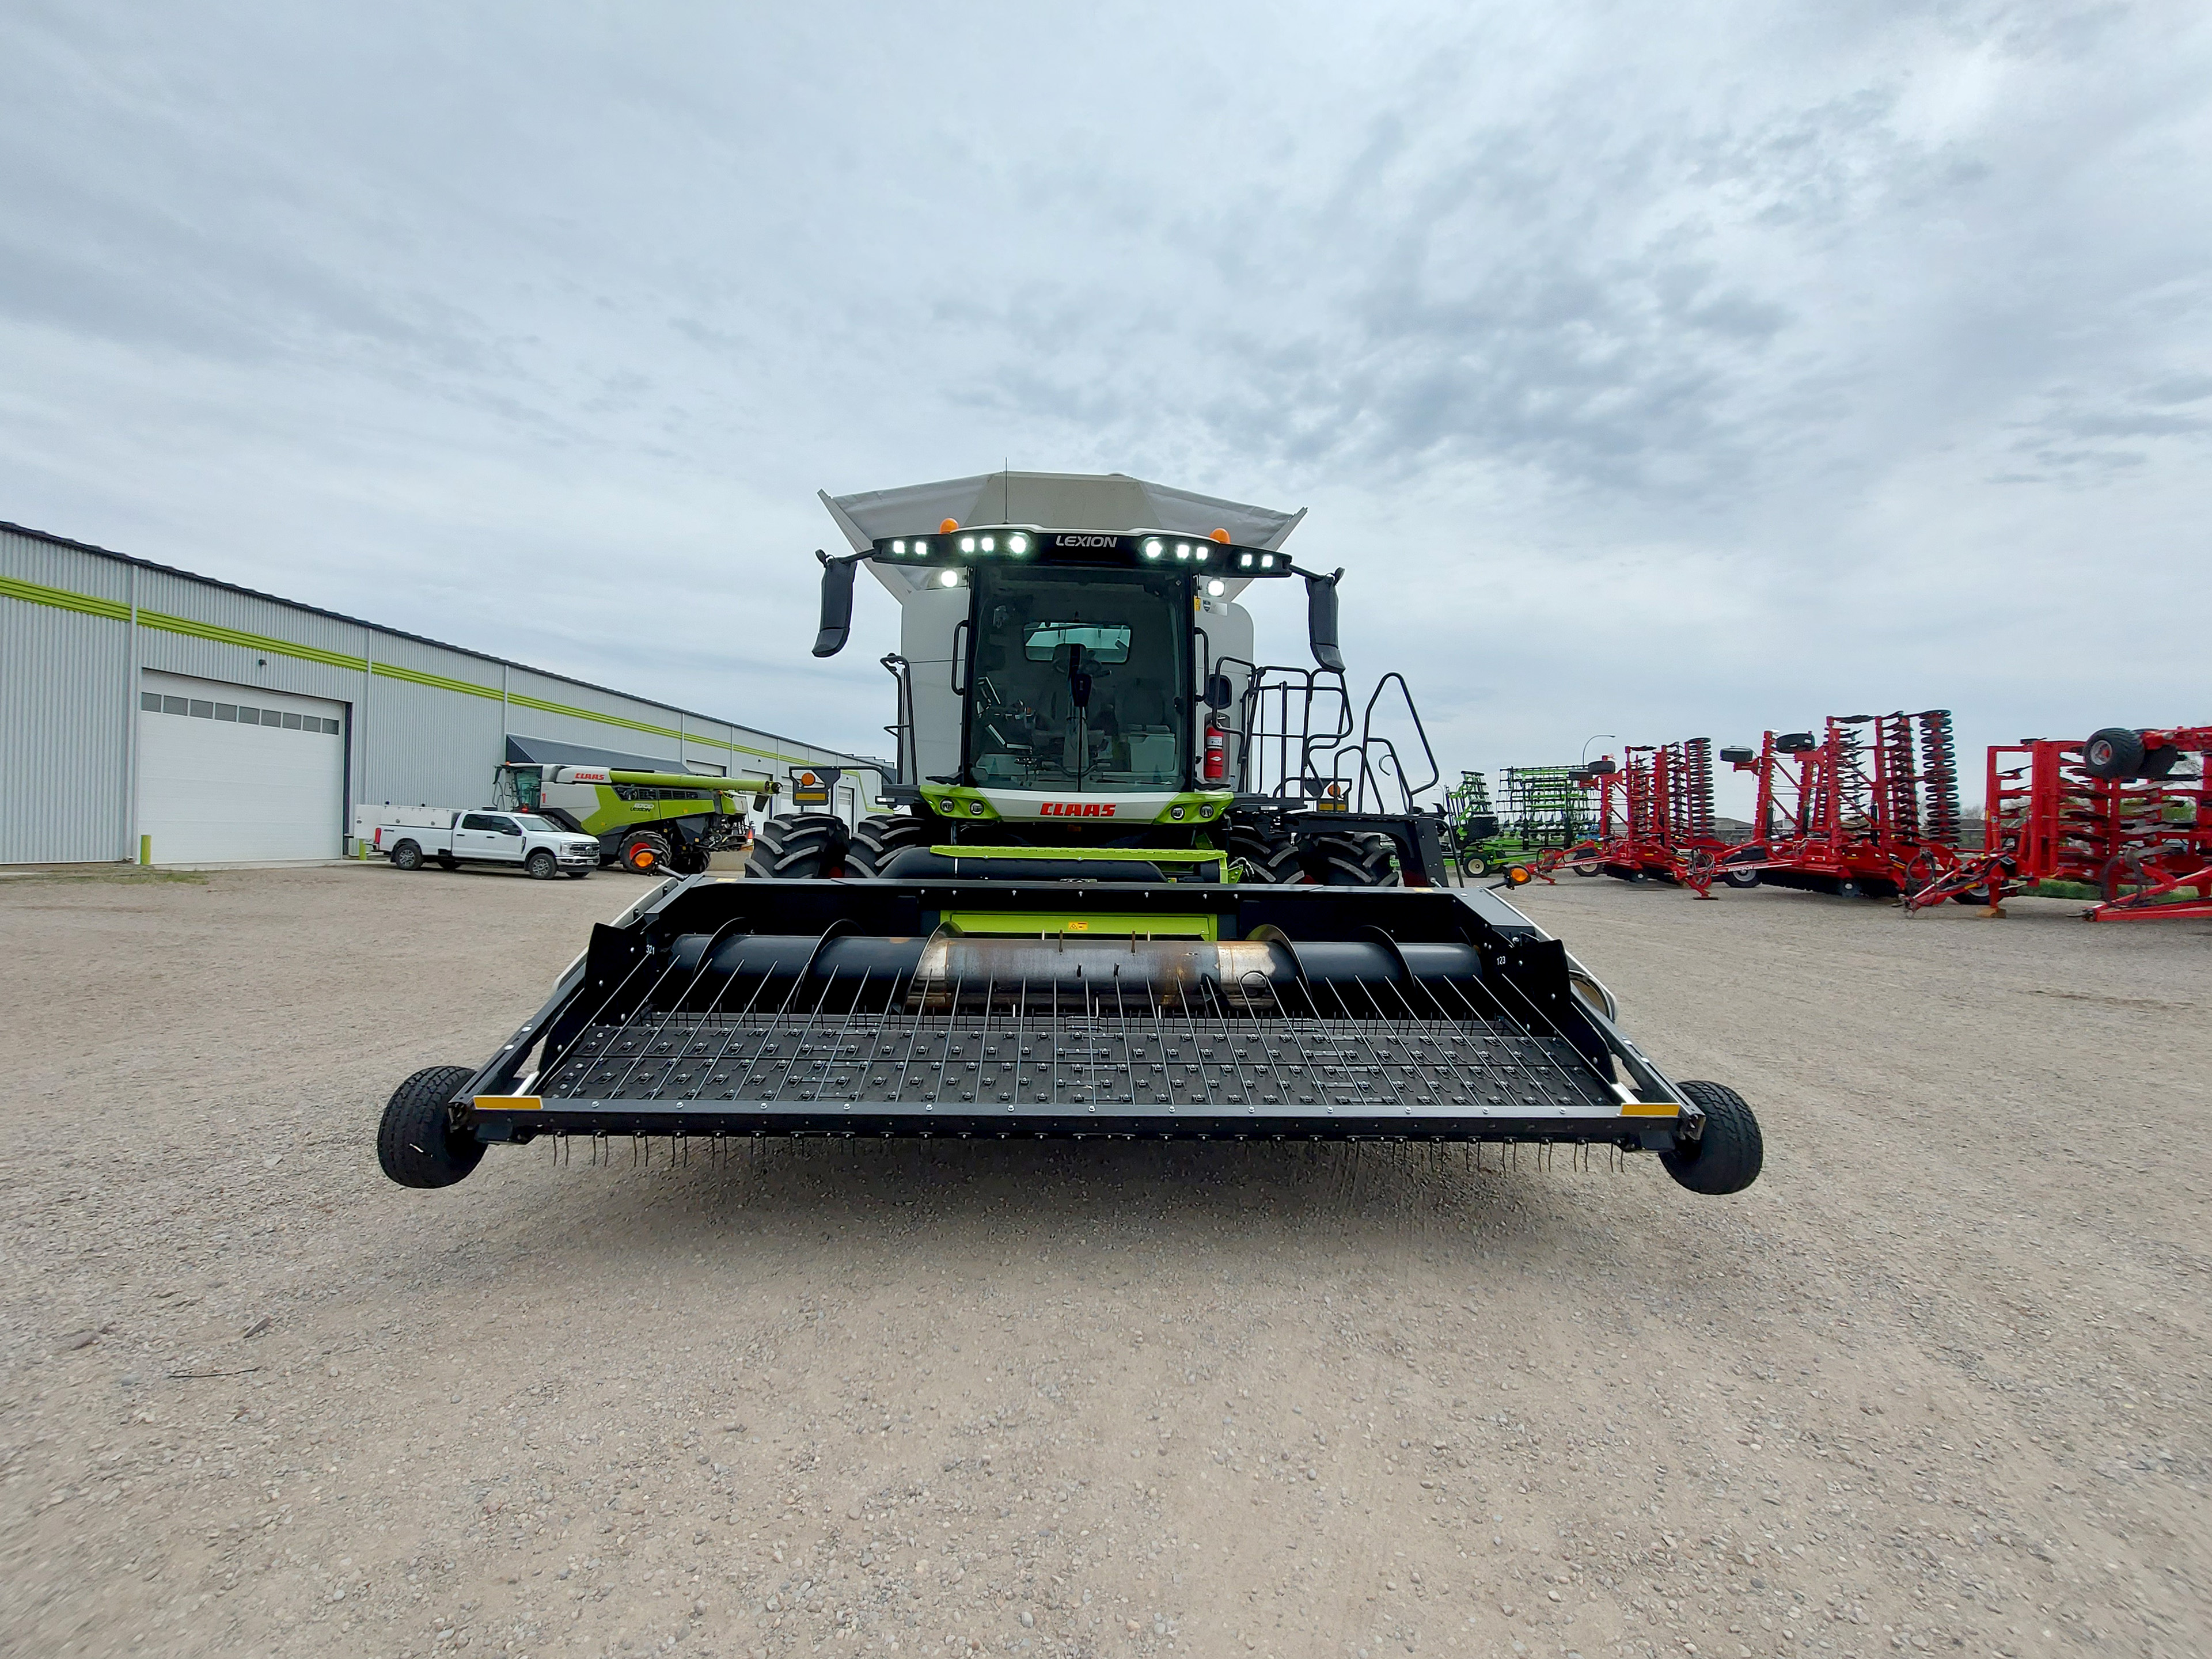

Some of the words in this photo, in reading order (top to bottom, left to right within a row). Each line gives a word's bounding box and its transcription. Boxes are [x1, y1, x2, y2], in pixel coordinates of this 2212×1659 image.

[1056, 535, 1118, 548] LEXION
[1039, 802, 1117, 817] CLAAS
[646, 944, 655, 955] 321
[1496, 955, 1506, 966] 123
